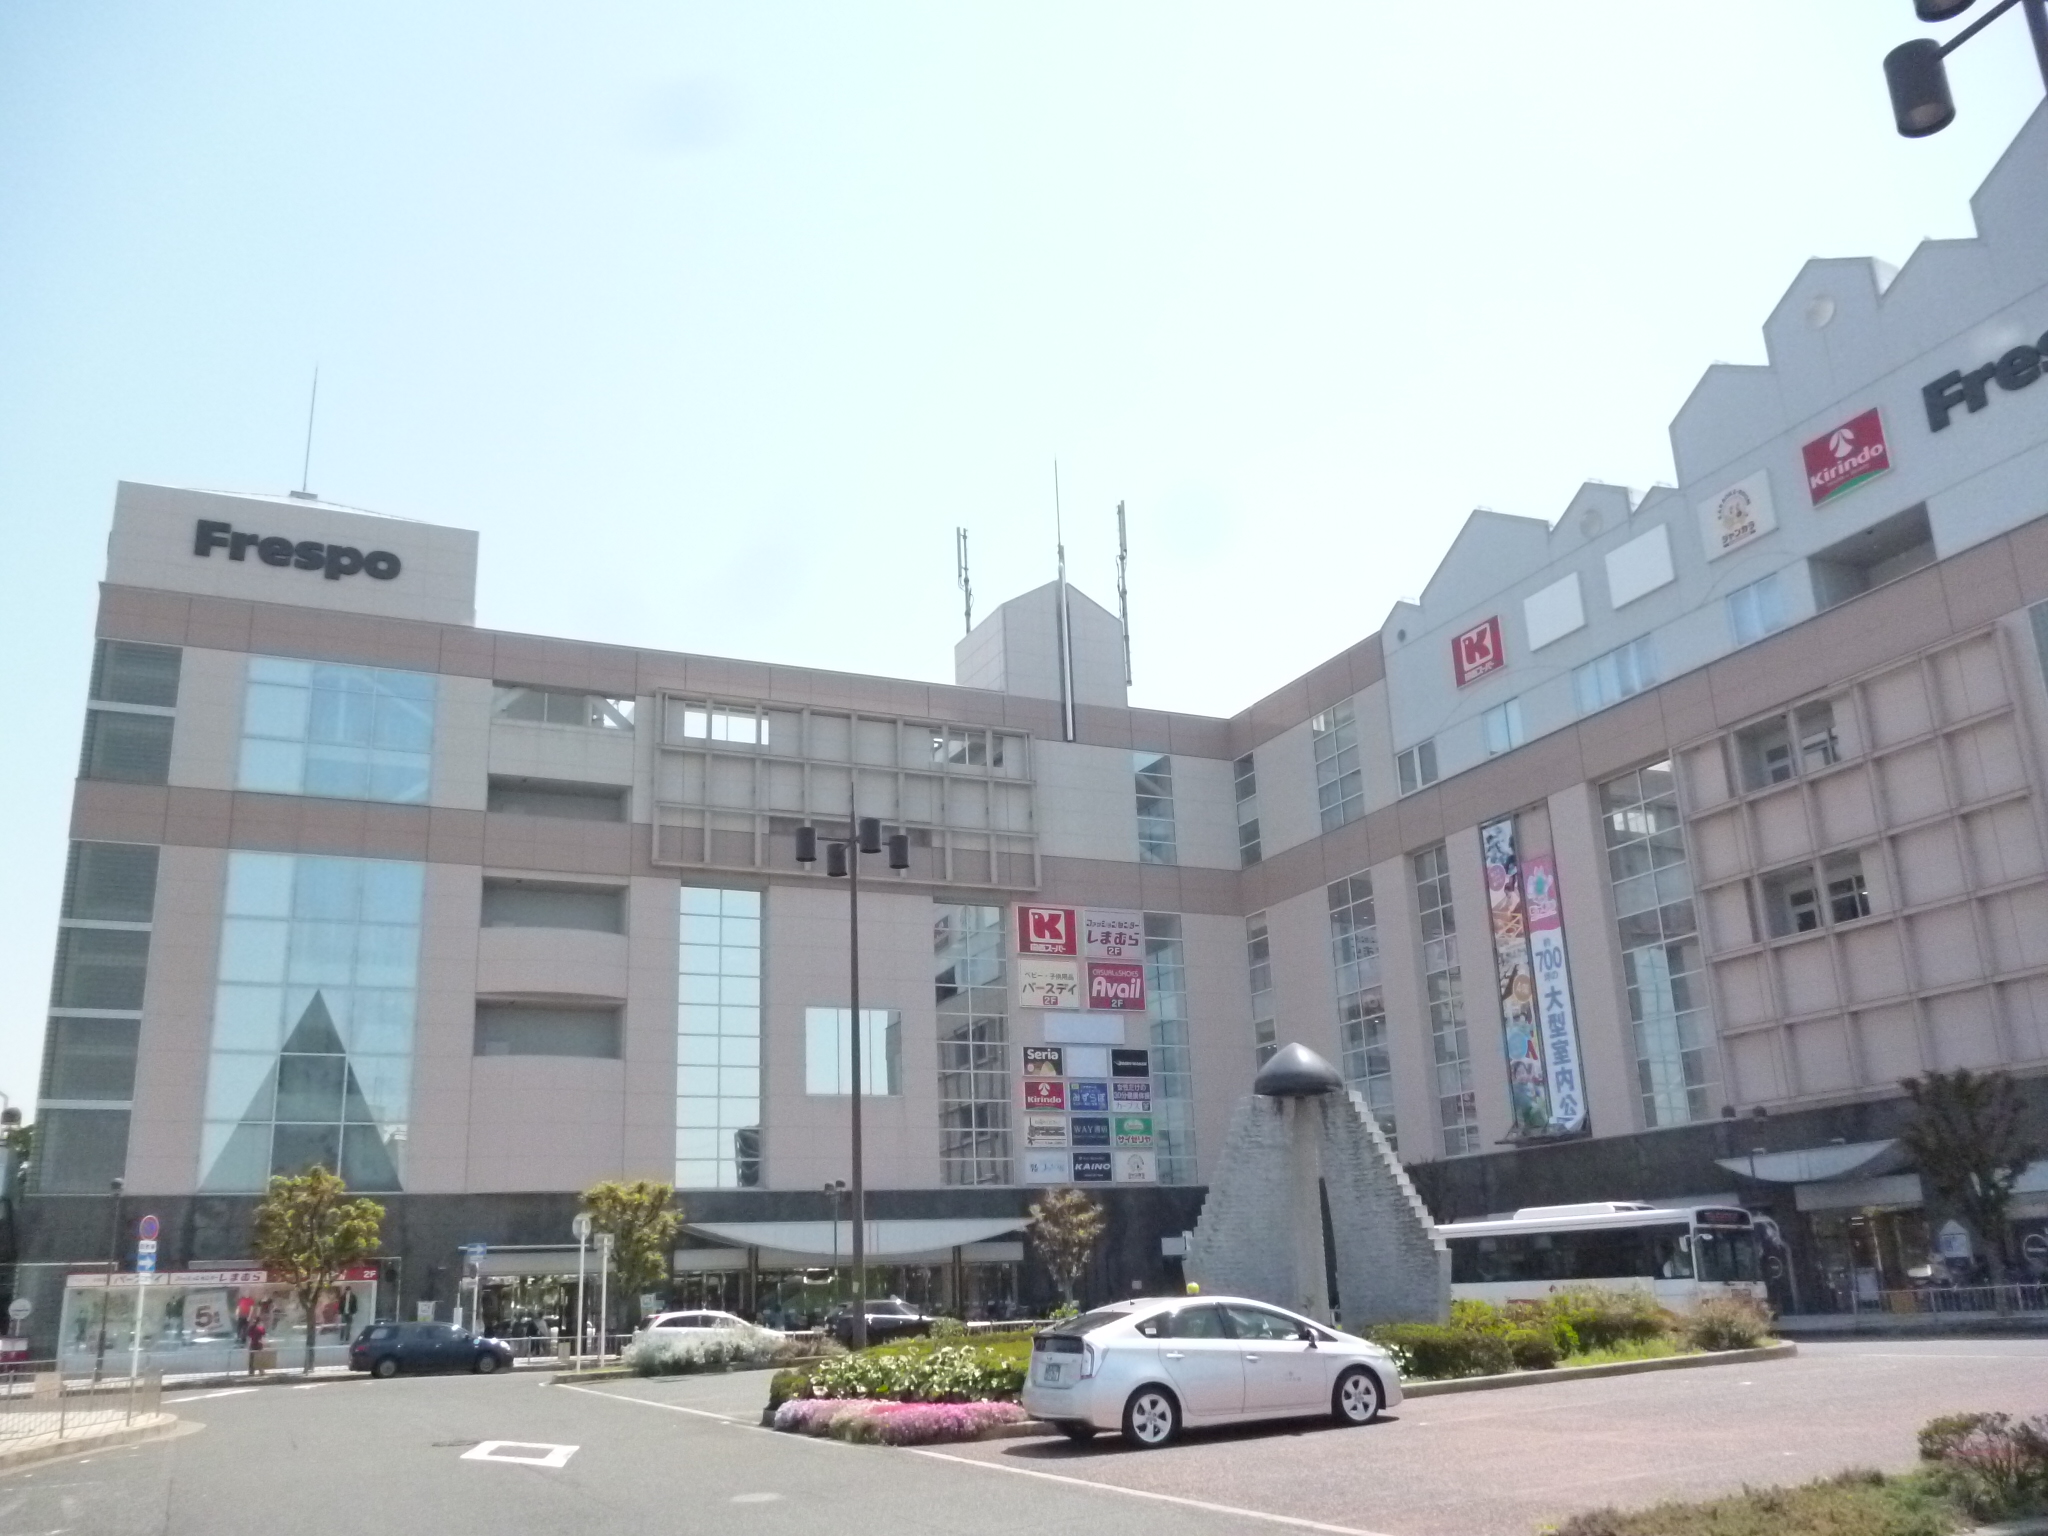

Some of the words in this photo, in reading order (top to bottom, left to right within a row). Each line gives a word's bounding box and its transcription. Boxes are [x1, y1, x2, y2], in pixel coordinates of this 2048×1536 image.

[1810, 443, 1883, 489] Kirindo
[194, 518, 402, 581] Frespo
[1087, 929, 1140, 947] しまむら
[1108, 947, 1121, 955] 2F
[1091, 976, 1141, 999] Avail
[1044, 996, 1057, 1005] 2F
[1111, 999, 1124, 1008] 2F
[1026, 1048, 1059, 1060] Seria
[1544, 985, 1578, 1124] 大型室内公
[1027, 1095, 1062, 1104] Kirindo
[1075, 1163, 1111, 1171] KAINO
[219, 1271, 262, 1283] しまむら
[363, 1268, 377, 1279] 2F
